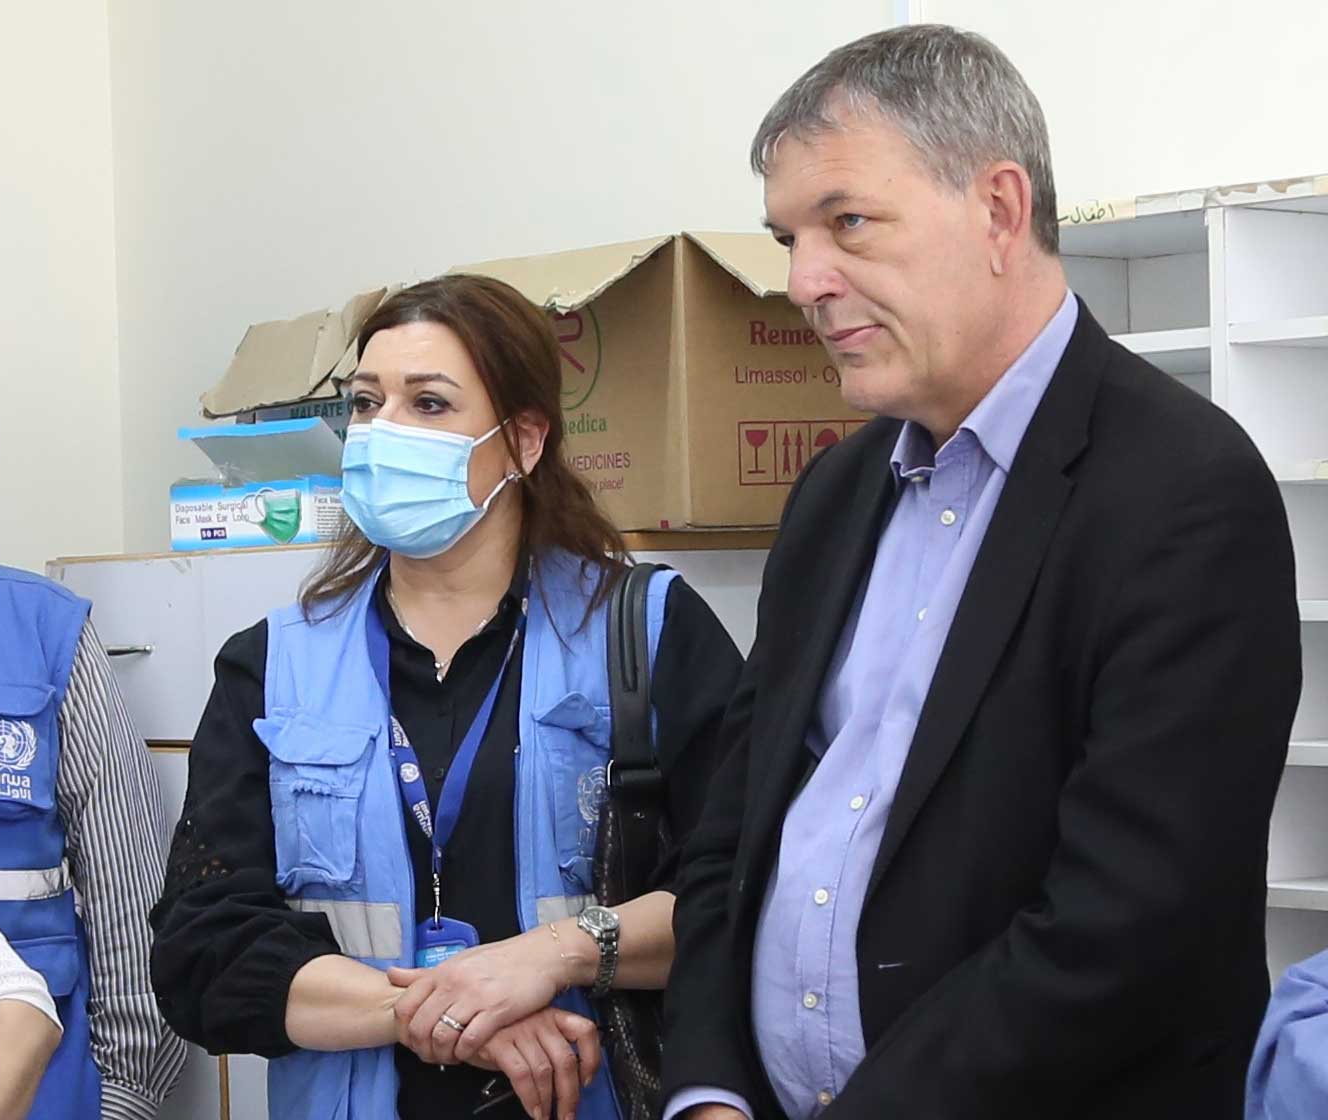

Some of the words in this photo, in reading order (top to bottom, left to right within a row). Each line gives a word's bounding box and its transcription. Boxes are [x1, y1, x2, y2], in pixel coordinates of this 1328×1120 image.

[734, 365, 807, 384] Limassol
[176, 515, 191, 524] Face
[195, 514, 212, 523] Mask
[216, 513, 228, 522] Ear
